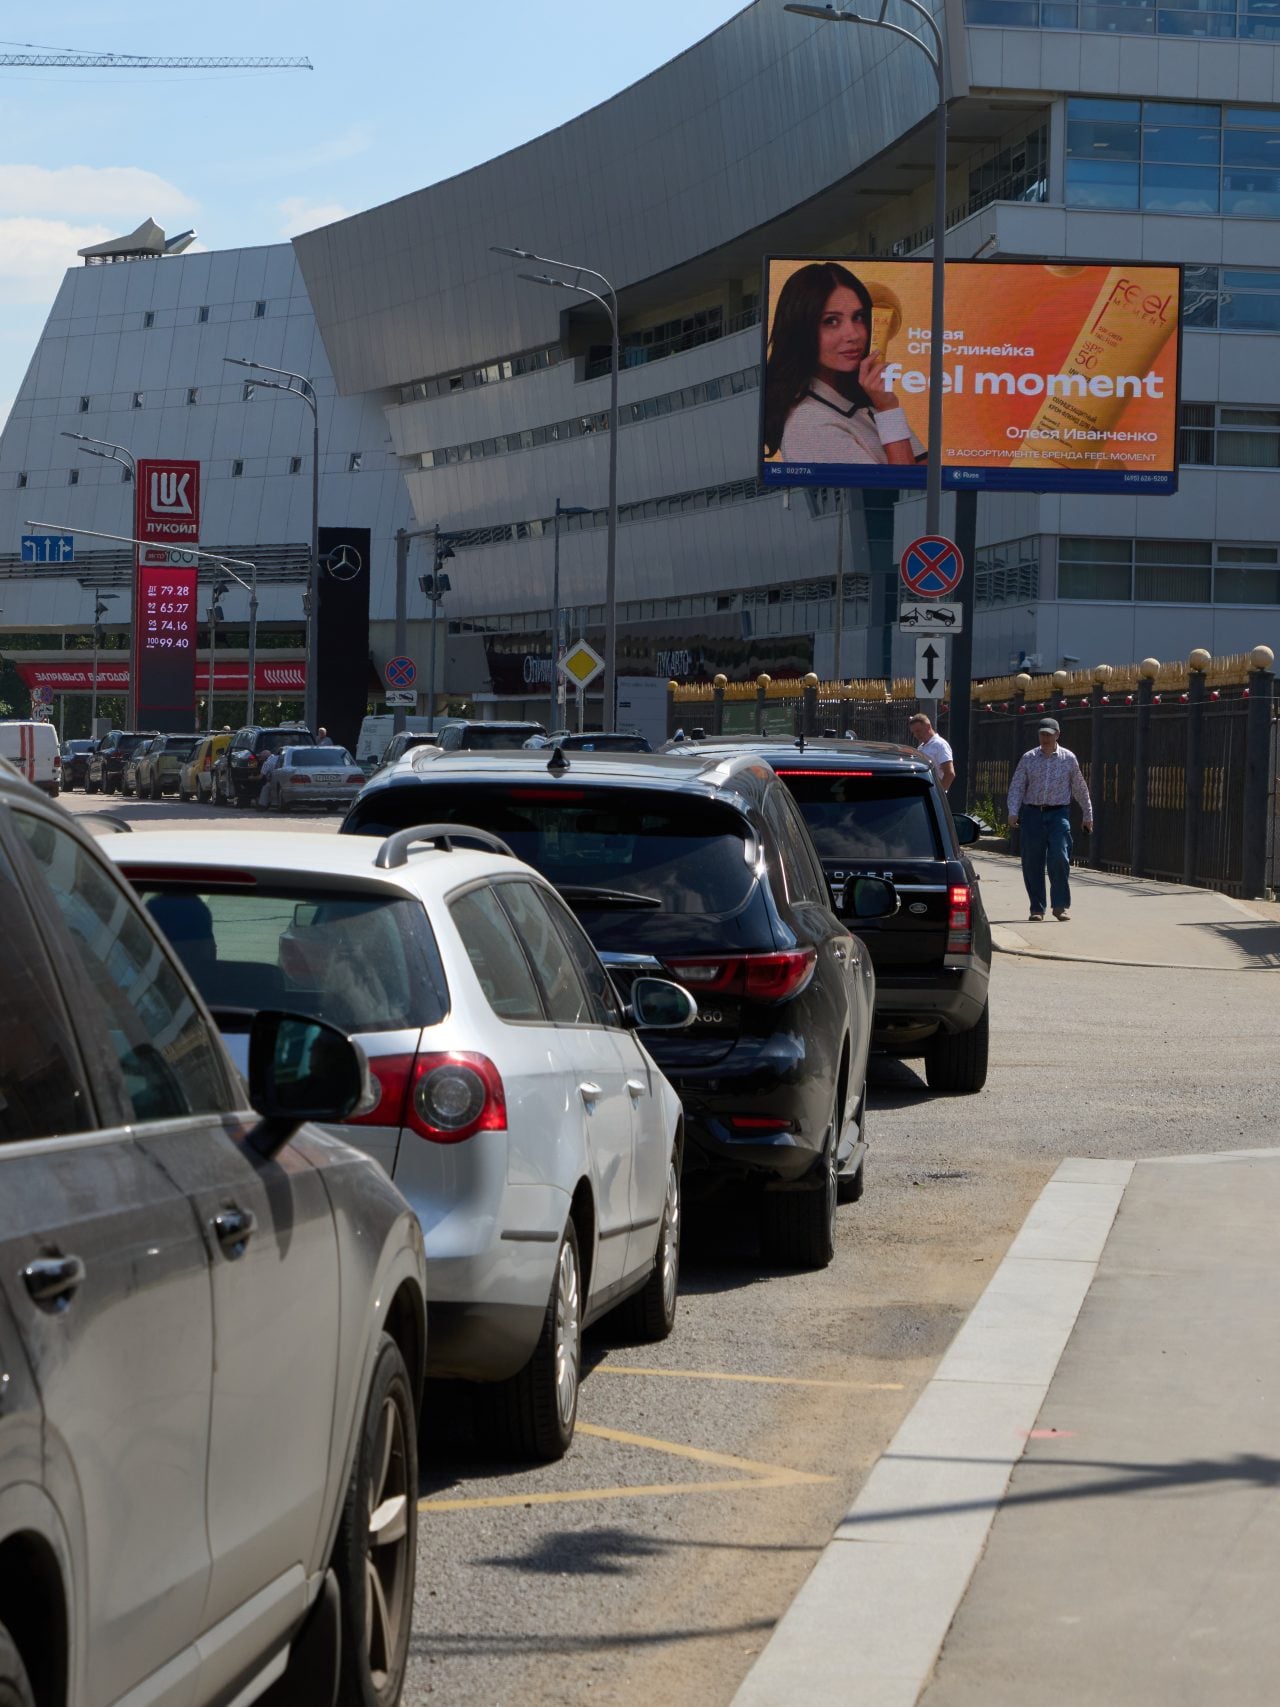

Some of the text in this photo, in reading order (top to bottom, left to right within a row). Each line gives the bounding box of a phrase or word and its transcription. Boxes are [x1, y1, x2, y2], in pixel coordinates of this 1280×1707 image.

[908, 327, 963, 340] Ноая
[1075, 350, 1098, 370] 50
[975, 370, 1164, 398] moment
[1006, 426, 1060, 441] Олеся
[1064, 428, 1158, 442] Иванченко
[956, 449, 1041, 459] АССОРТИМЕНТЕ
[1042, 451, 1084, 460] БРЕНДА
[145, 521, 197, 534] ЛУКОЙЛ
[161, 585, 189, 596] 79.28
[160, 602, 189, 613] 65.27
[161, 620, 188, 631] 74.16
[159, 638, 189, 648] 99.40
[35, 672, 86, 682] ЗАПРАВЬСЯ
[824, 871, 894, 879] OVER
